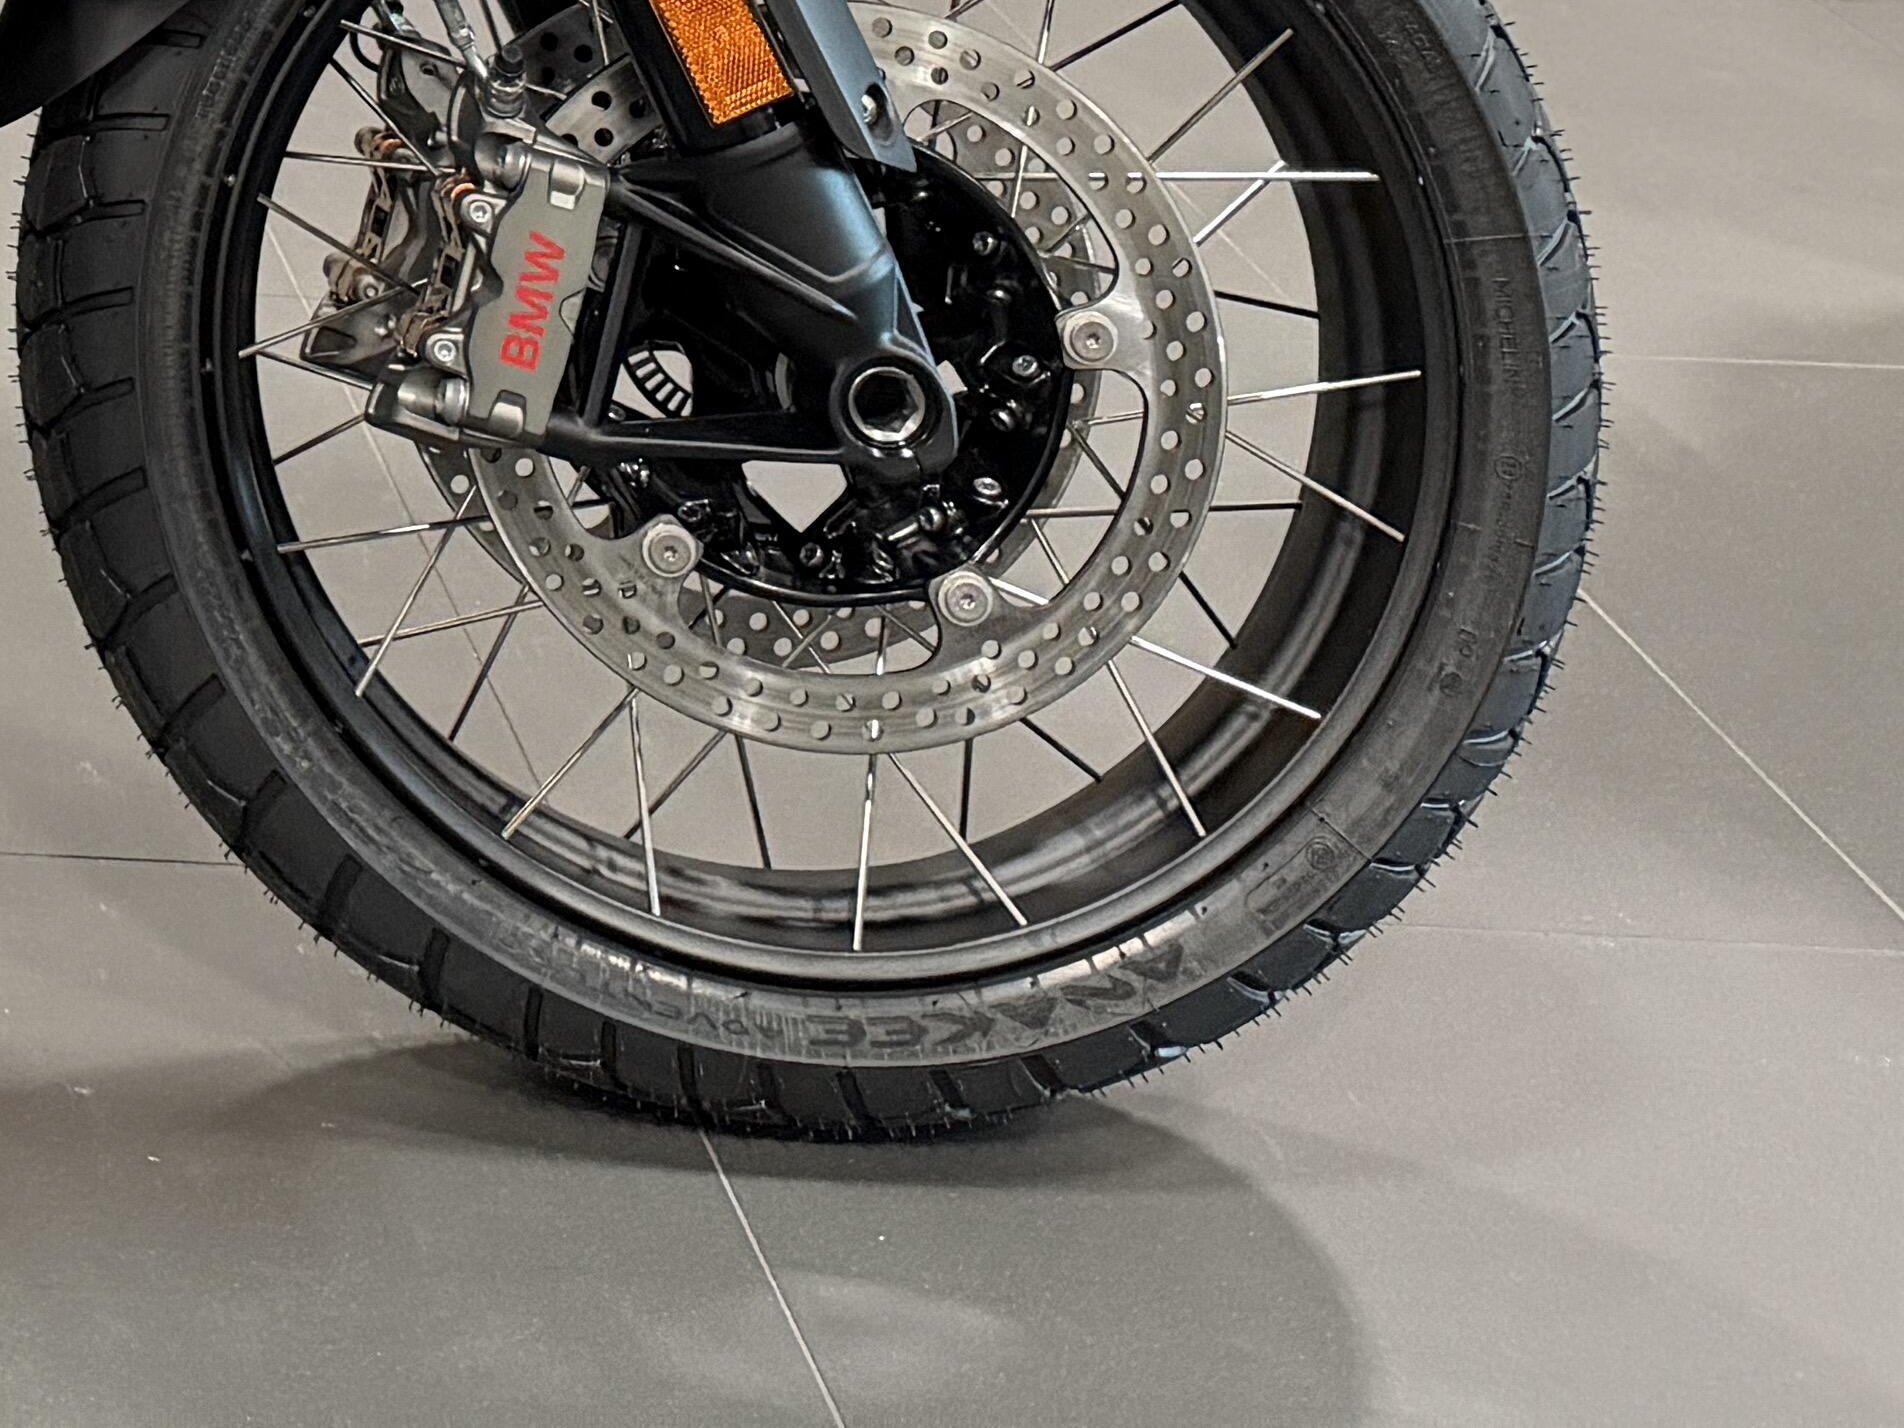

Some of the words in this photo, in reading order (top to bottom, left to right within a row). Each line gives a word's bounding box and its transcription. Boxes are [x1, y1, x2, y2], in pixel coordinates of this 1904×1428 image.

[499, 229, 565, 373] BMW
[1491, 275, 1520, 380] MICHELIN
[806, 935, 1195, 1051] ANAKEE
